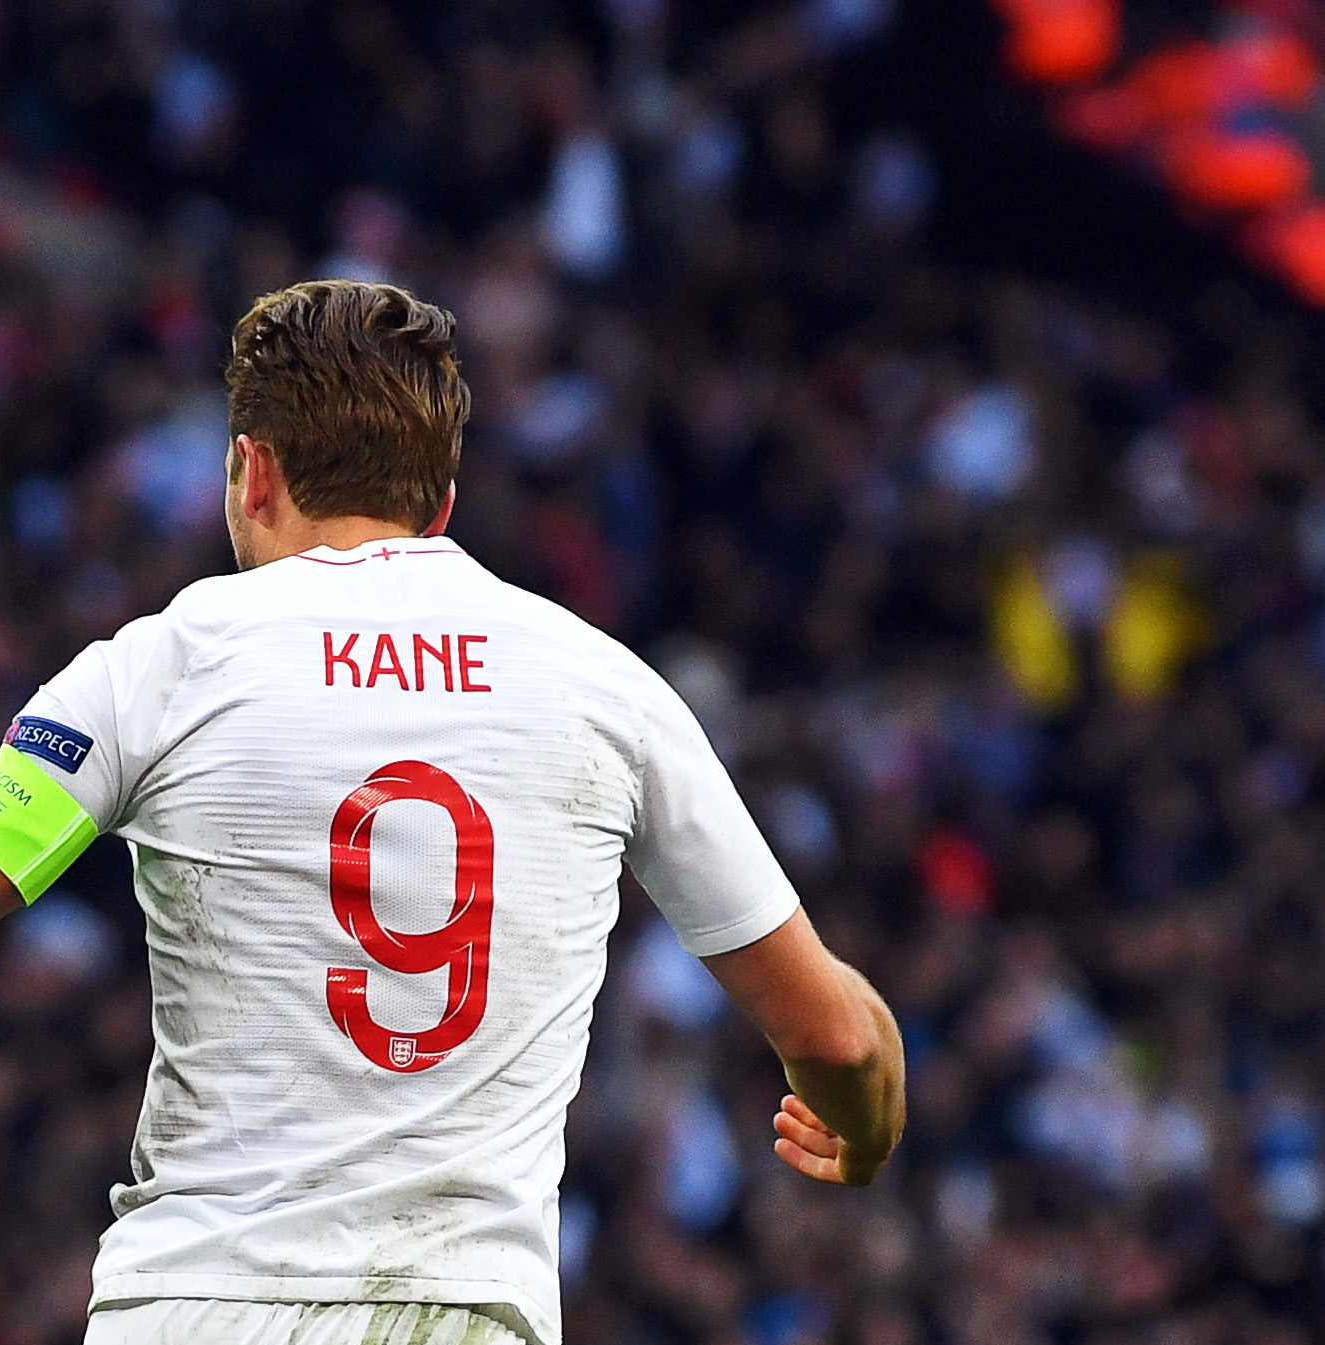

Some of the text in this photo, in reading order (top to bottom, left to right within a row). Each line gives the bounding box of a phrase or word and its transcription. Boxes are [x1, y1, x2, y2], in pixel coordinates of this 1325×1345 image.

[323, 632, 492, 692] KANE
[15, 726, 87, 762] RESPECT
[326, 760, 494, 1073] 9
